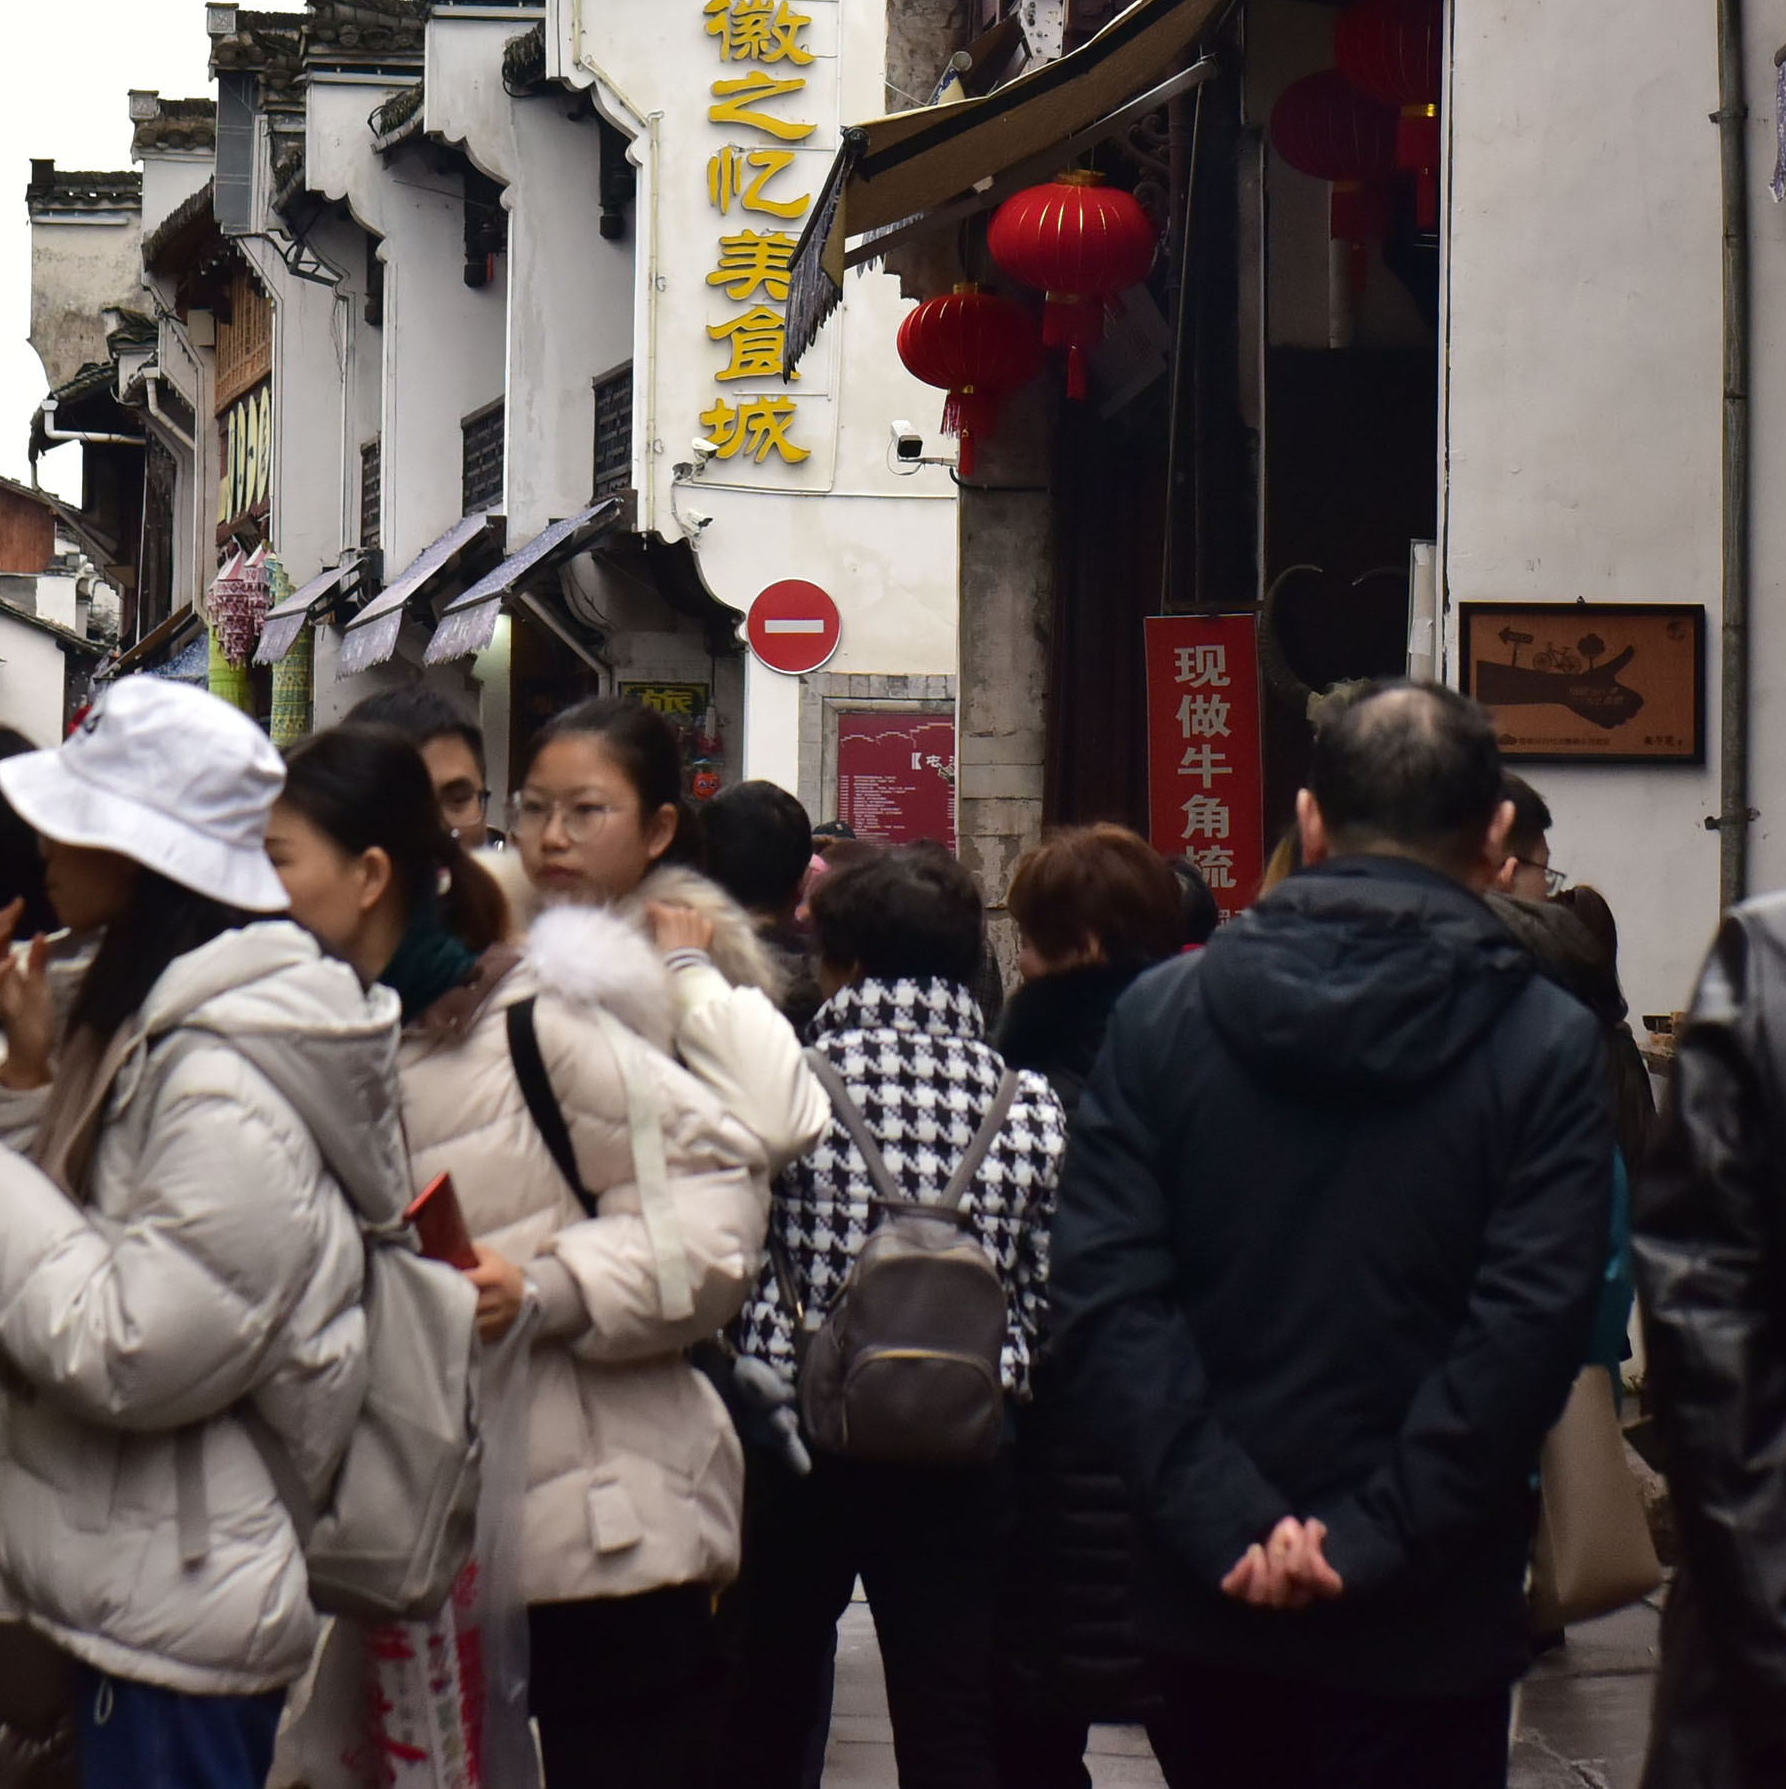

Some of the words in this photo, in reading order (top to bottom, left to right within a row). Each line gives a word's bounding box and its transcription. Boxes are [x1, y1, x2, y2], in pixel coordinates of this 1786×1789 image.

[1173, 644, 1238, 889] 现做牛角梳
